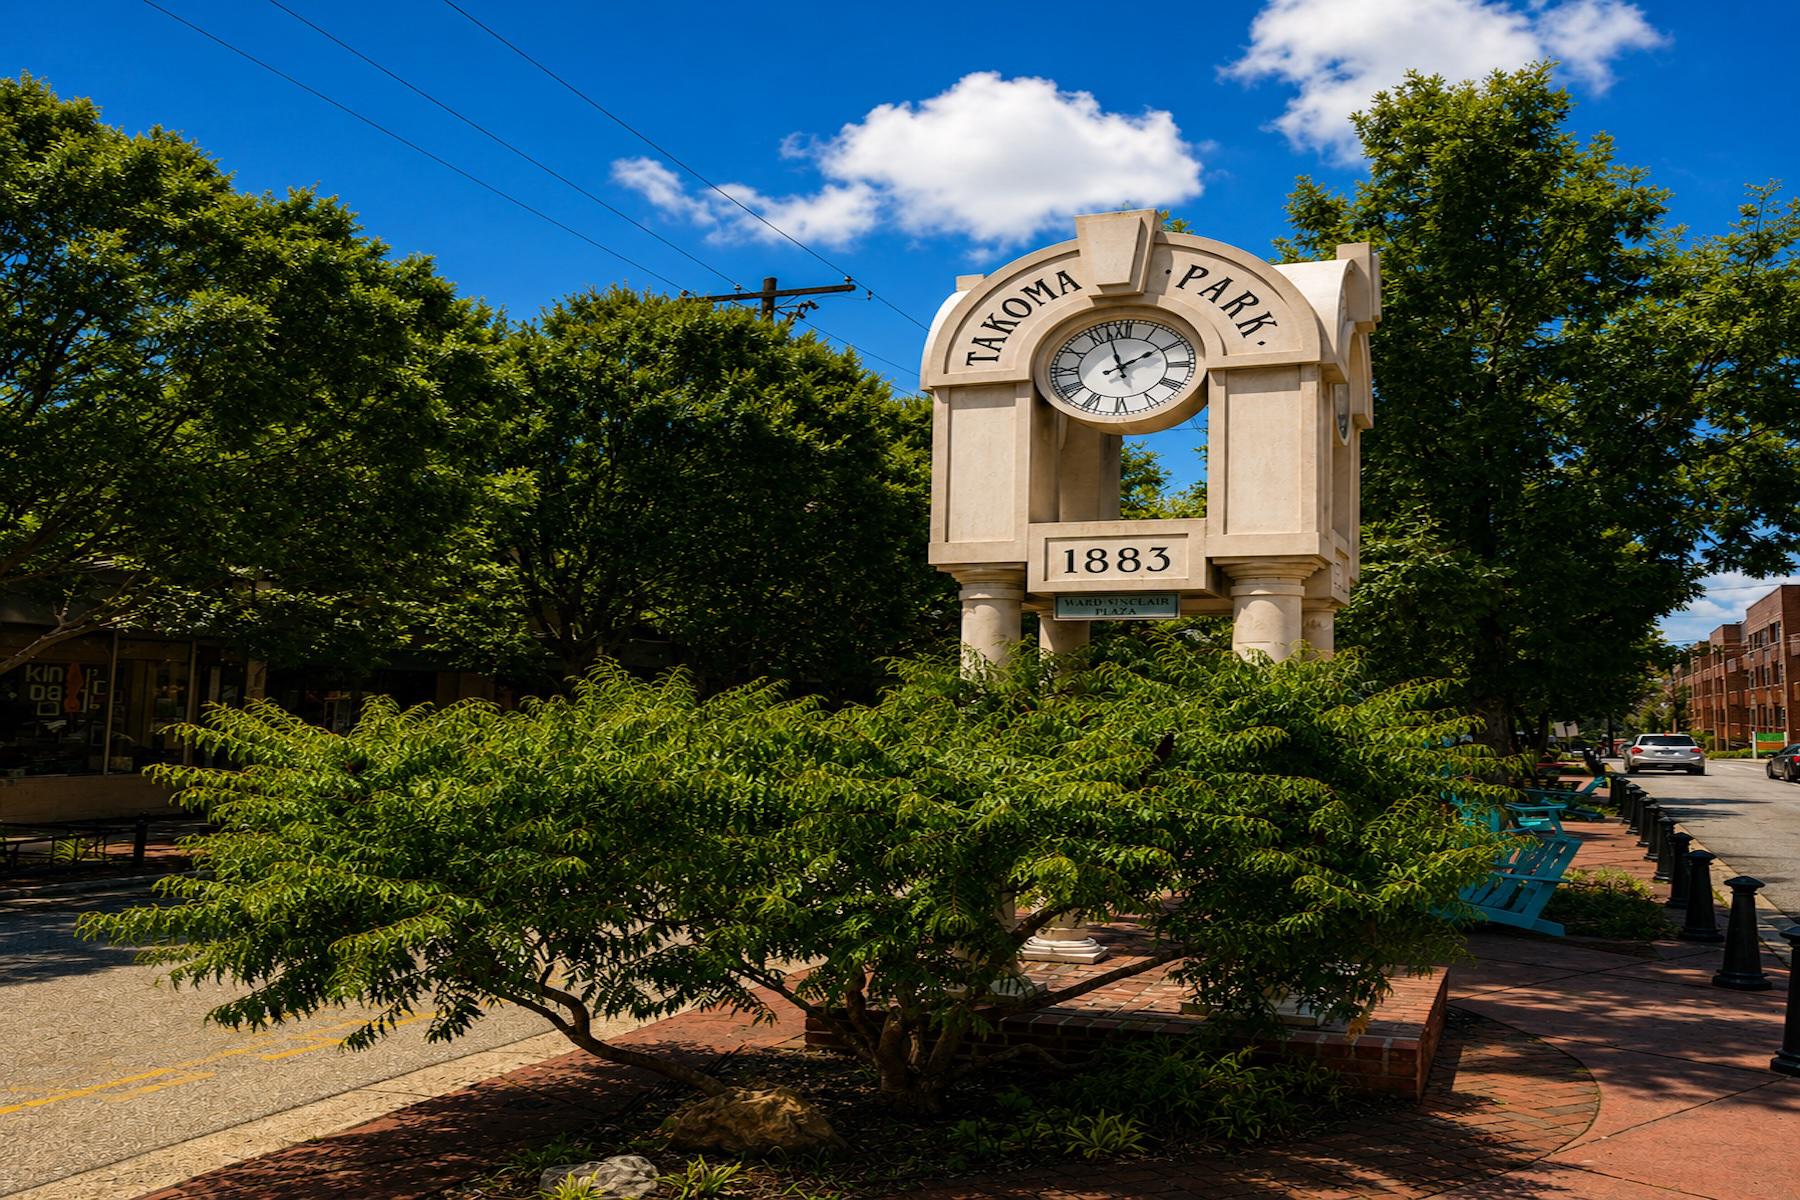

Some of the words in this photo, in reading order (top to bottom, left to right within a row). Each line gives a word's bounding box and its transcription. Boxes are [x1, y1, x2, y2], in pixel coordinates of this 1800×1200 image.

[966, 270, 1082, 366] TAKOMA
[1064, 546, 1171, 574] 1883
[1065, 598, 1102, 607] WARD
[1108, 597, 1169, 606] SINCLAIR
[1095, 607, 1136, 616] PLAZA
